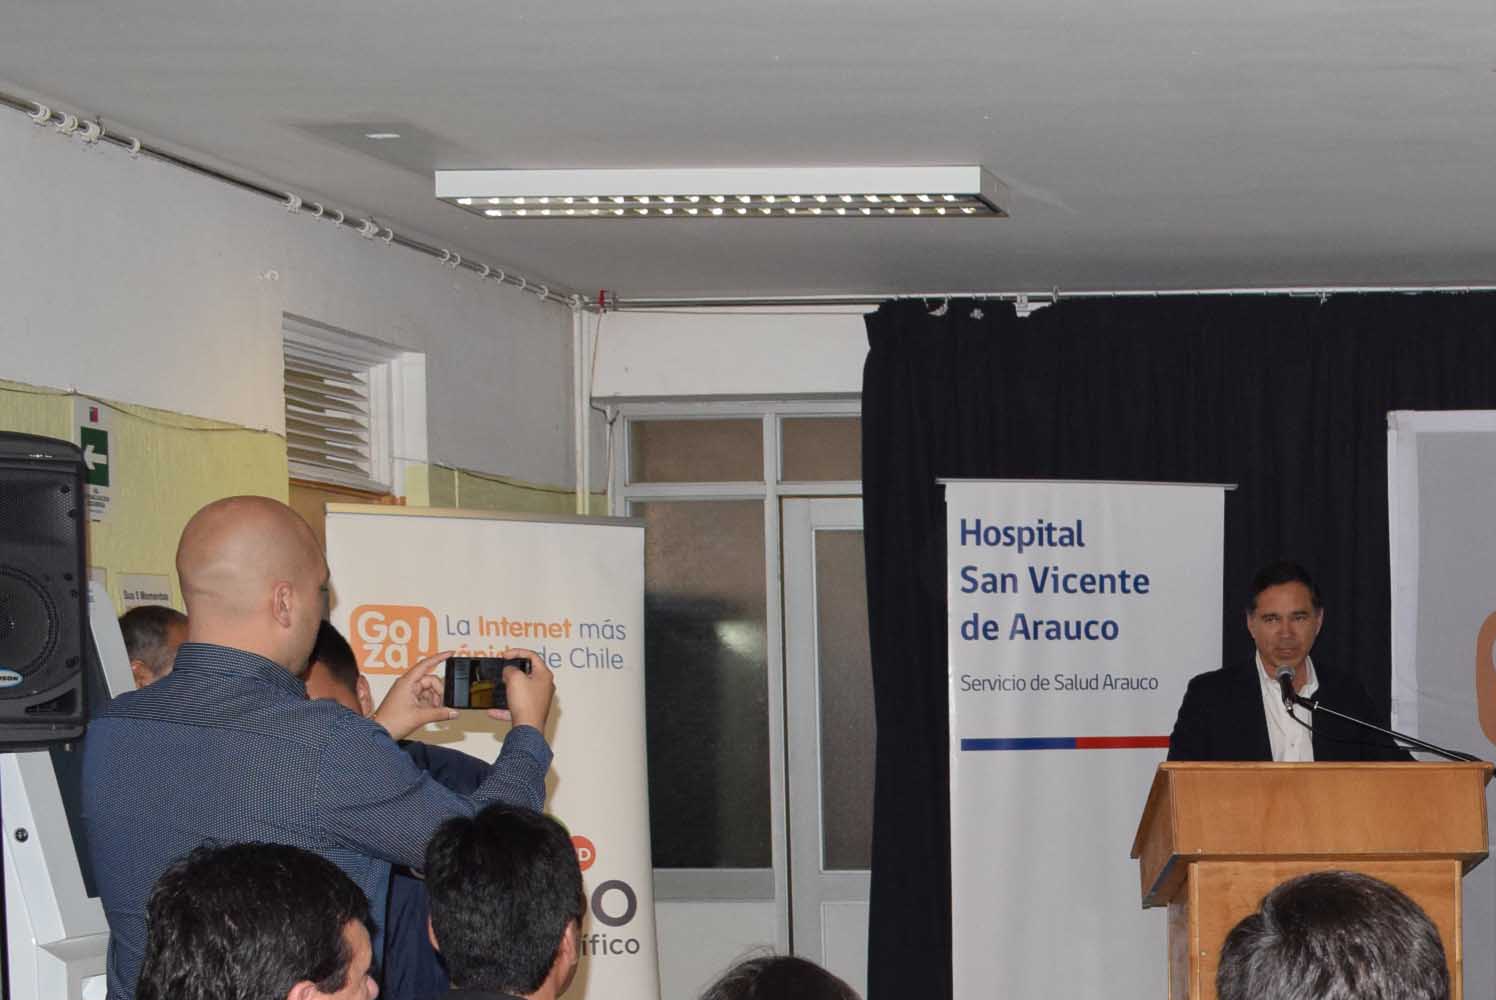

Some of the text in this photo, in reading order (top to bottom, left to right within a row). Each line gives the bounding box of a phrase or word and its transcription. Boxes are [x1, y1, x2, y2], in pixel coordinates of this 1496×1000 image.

[960, 518, 1085, 554] Hospital
[960, 565, 1150, 595] San Vicente
[446, 614, 627, 641] La Internet más
[960, 612, 1120, 641] de Arauco
[569, 648, 625, 670] Chile
[960, 673, 1159, 692] Servicio de Salud Arauco
[580, 933, 640, 956] ífico
